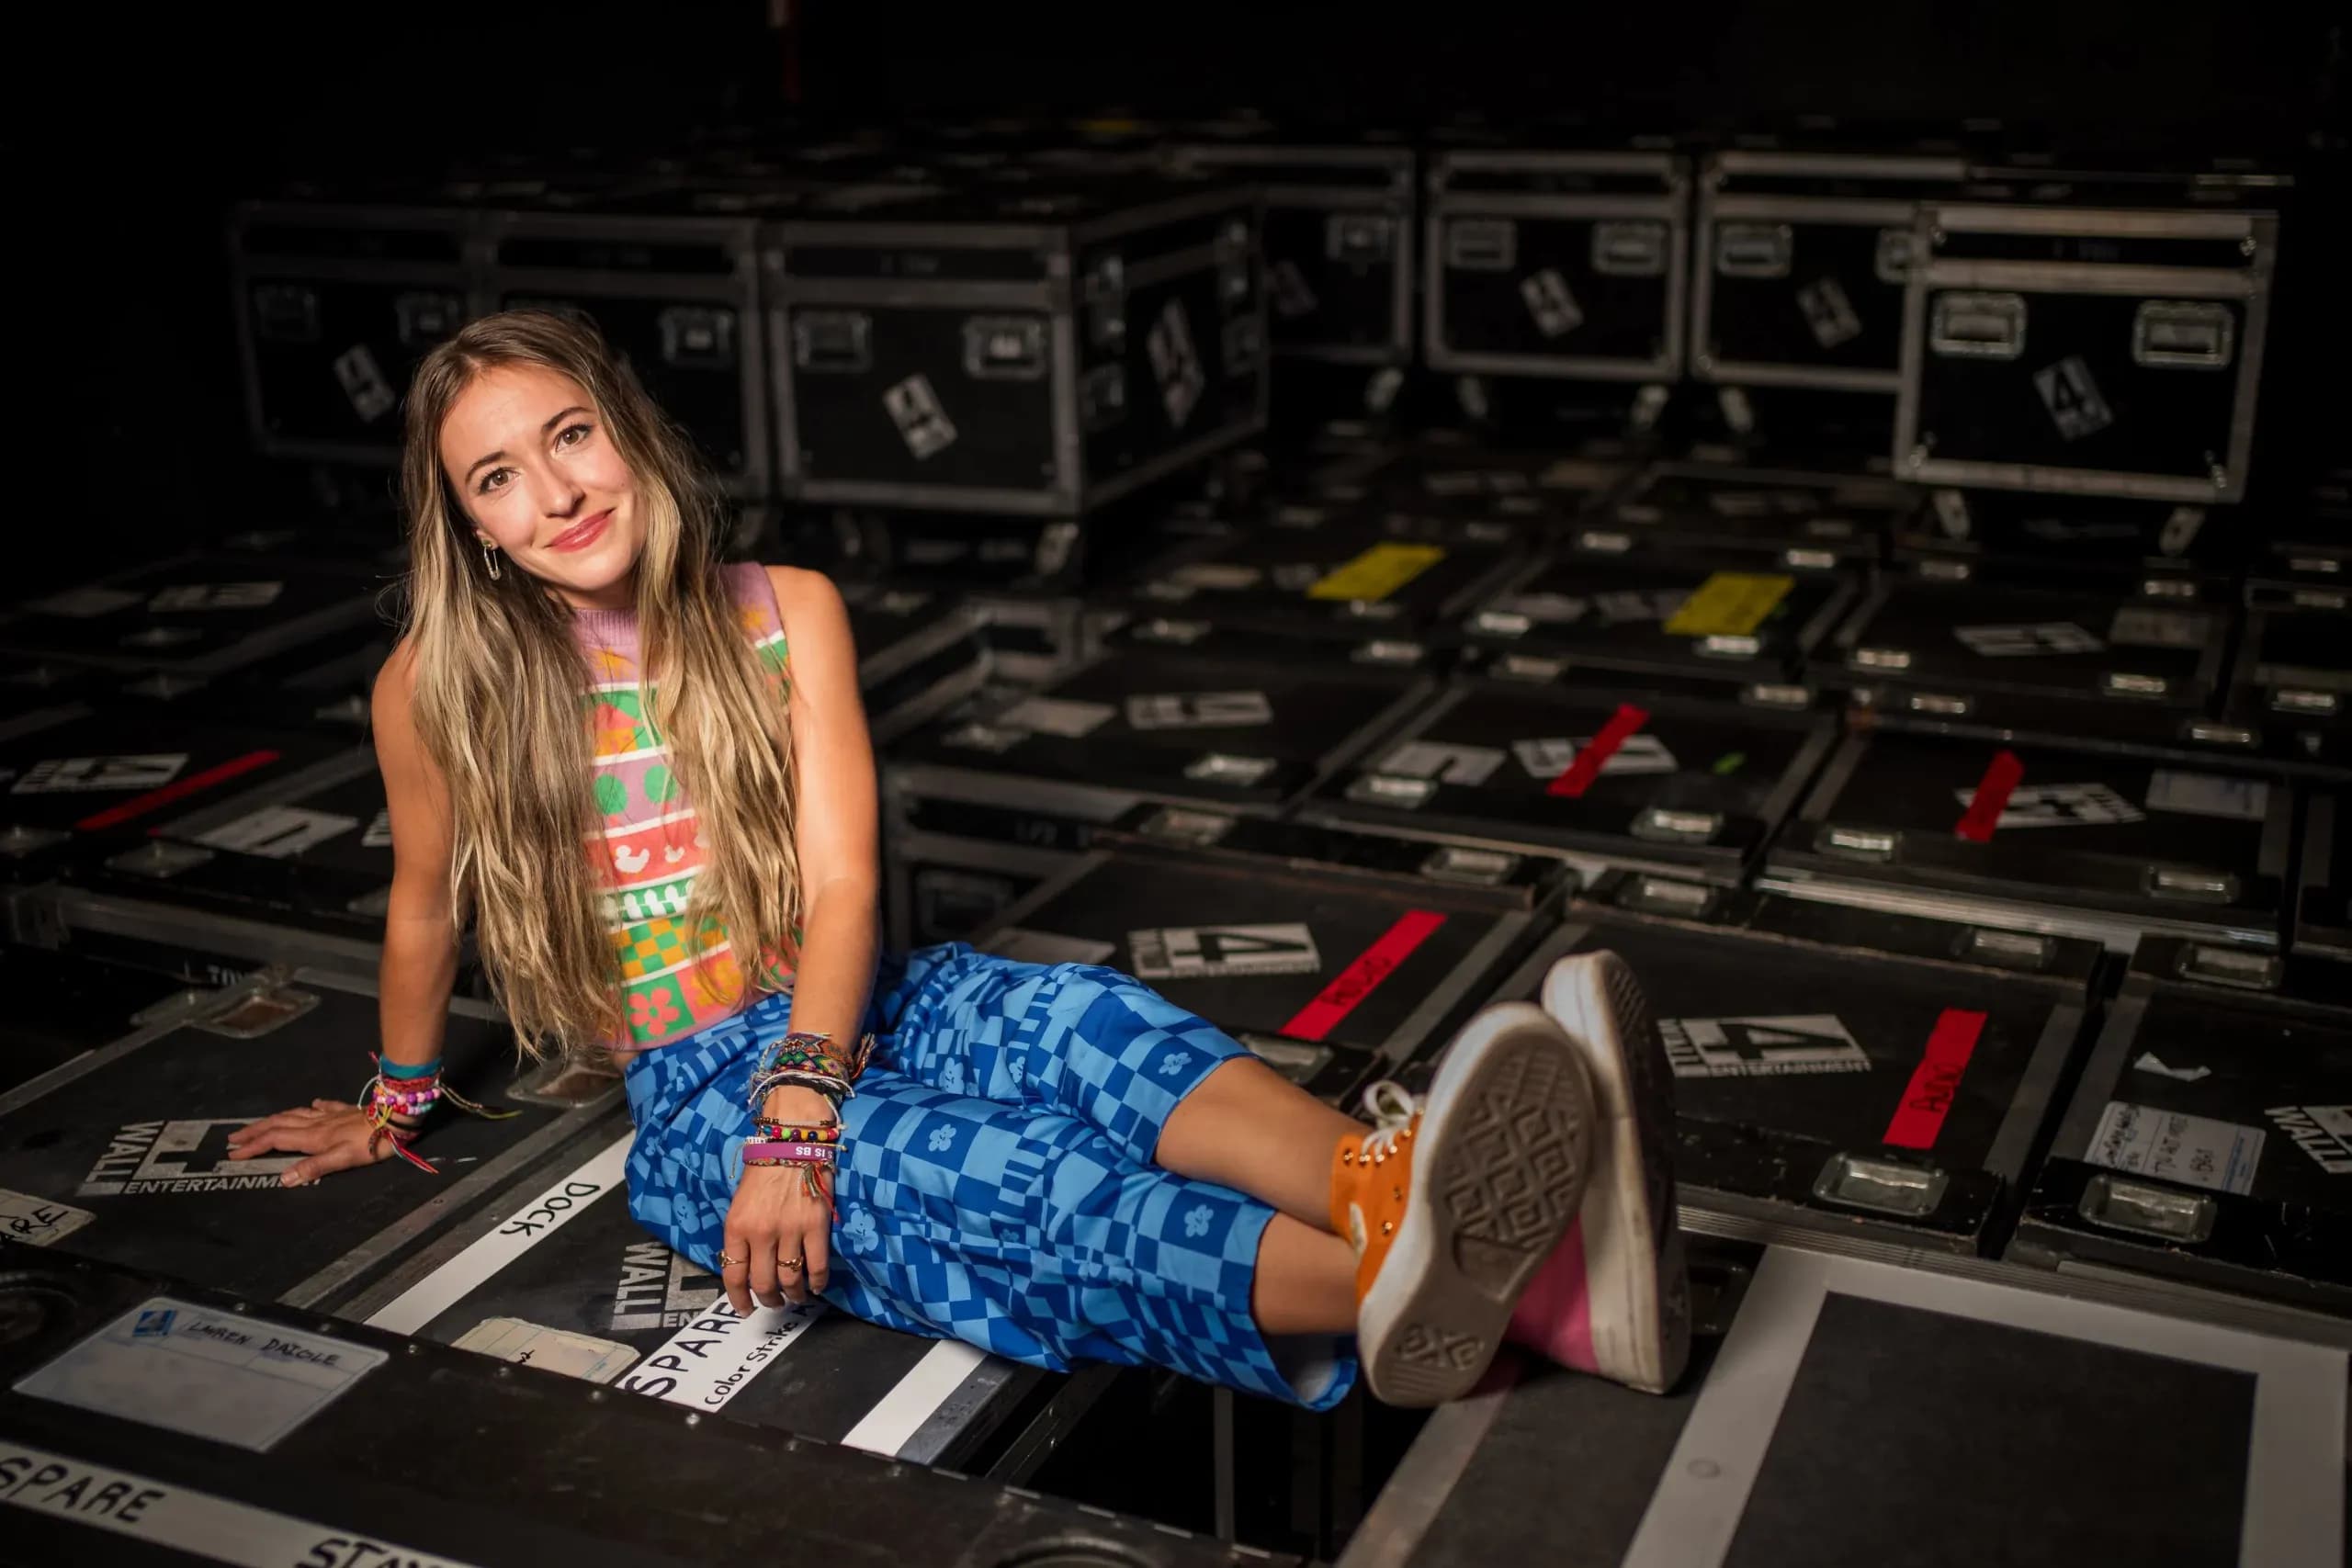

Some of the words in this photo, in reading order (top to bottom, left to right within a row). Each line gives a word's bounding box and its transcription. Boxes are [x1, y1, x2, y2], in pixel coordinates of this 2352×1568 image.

[85, 1120, 164, 1183] WALL
[499, 1181, 602, 1236] DOCK
[0, 1457, 166, 1523] SPARE
